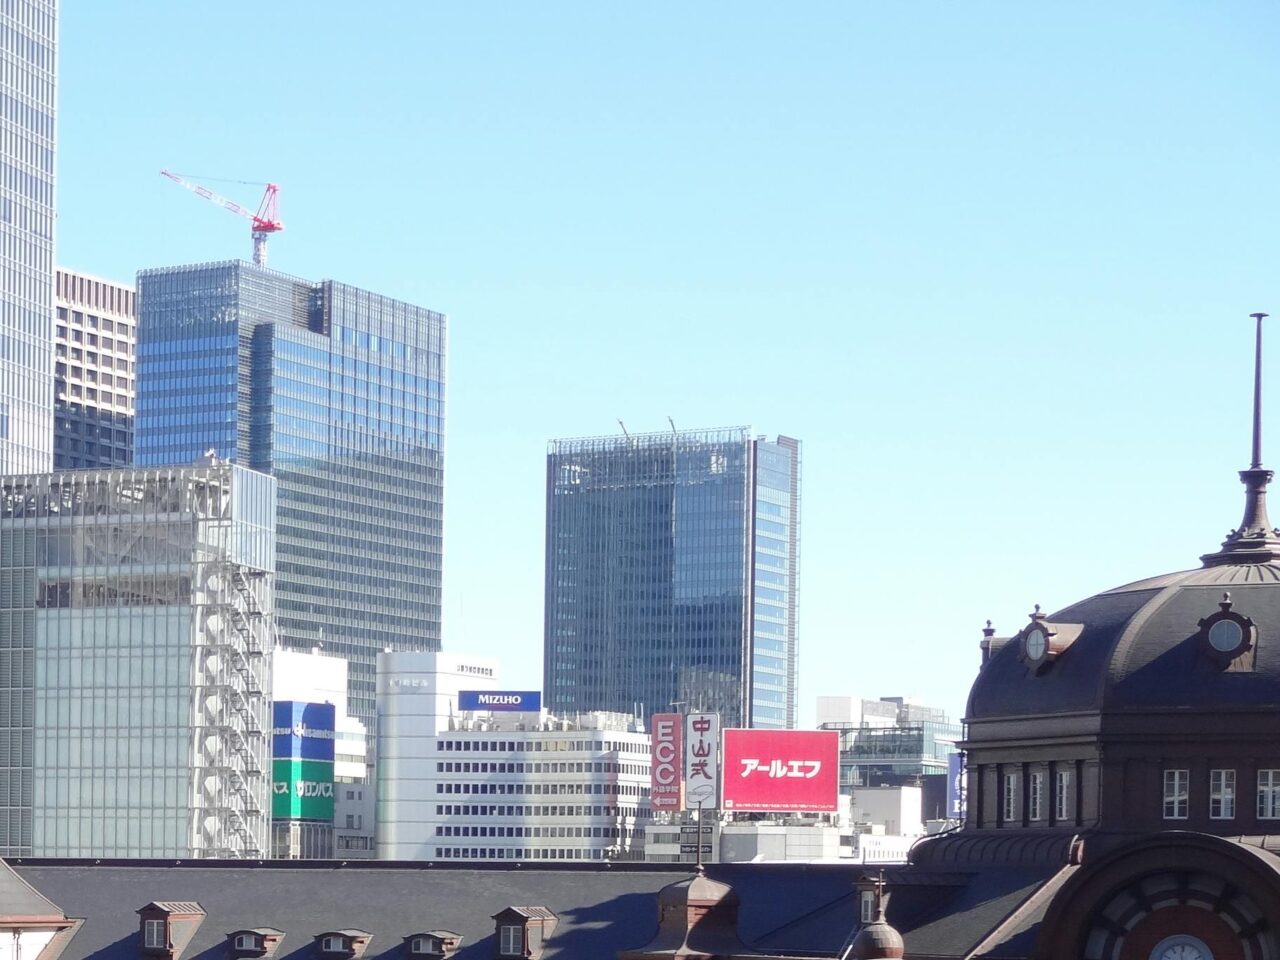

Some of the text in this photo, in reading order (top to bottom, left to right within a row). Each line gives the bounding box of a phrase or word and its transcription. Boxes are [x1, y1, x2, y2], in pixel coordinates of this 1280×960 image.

[478, 694, 521, 705] MIZUHO
[655, 720, 675, 785] ECC
[690, 716, 712, 780] 中山式
[740, 758, 821, 779] アールエフ
